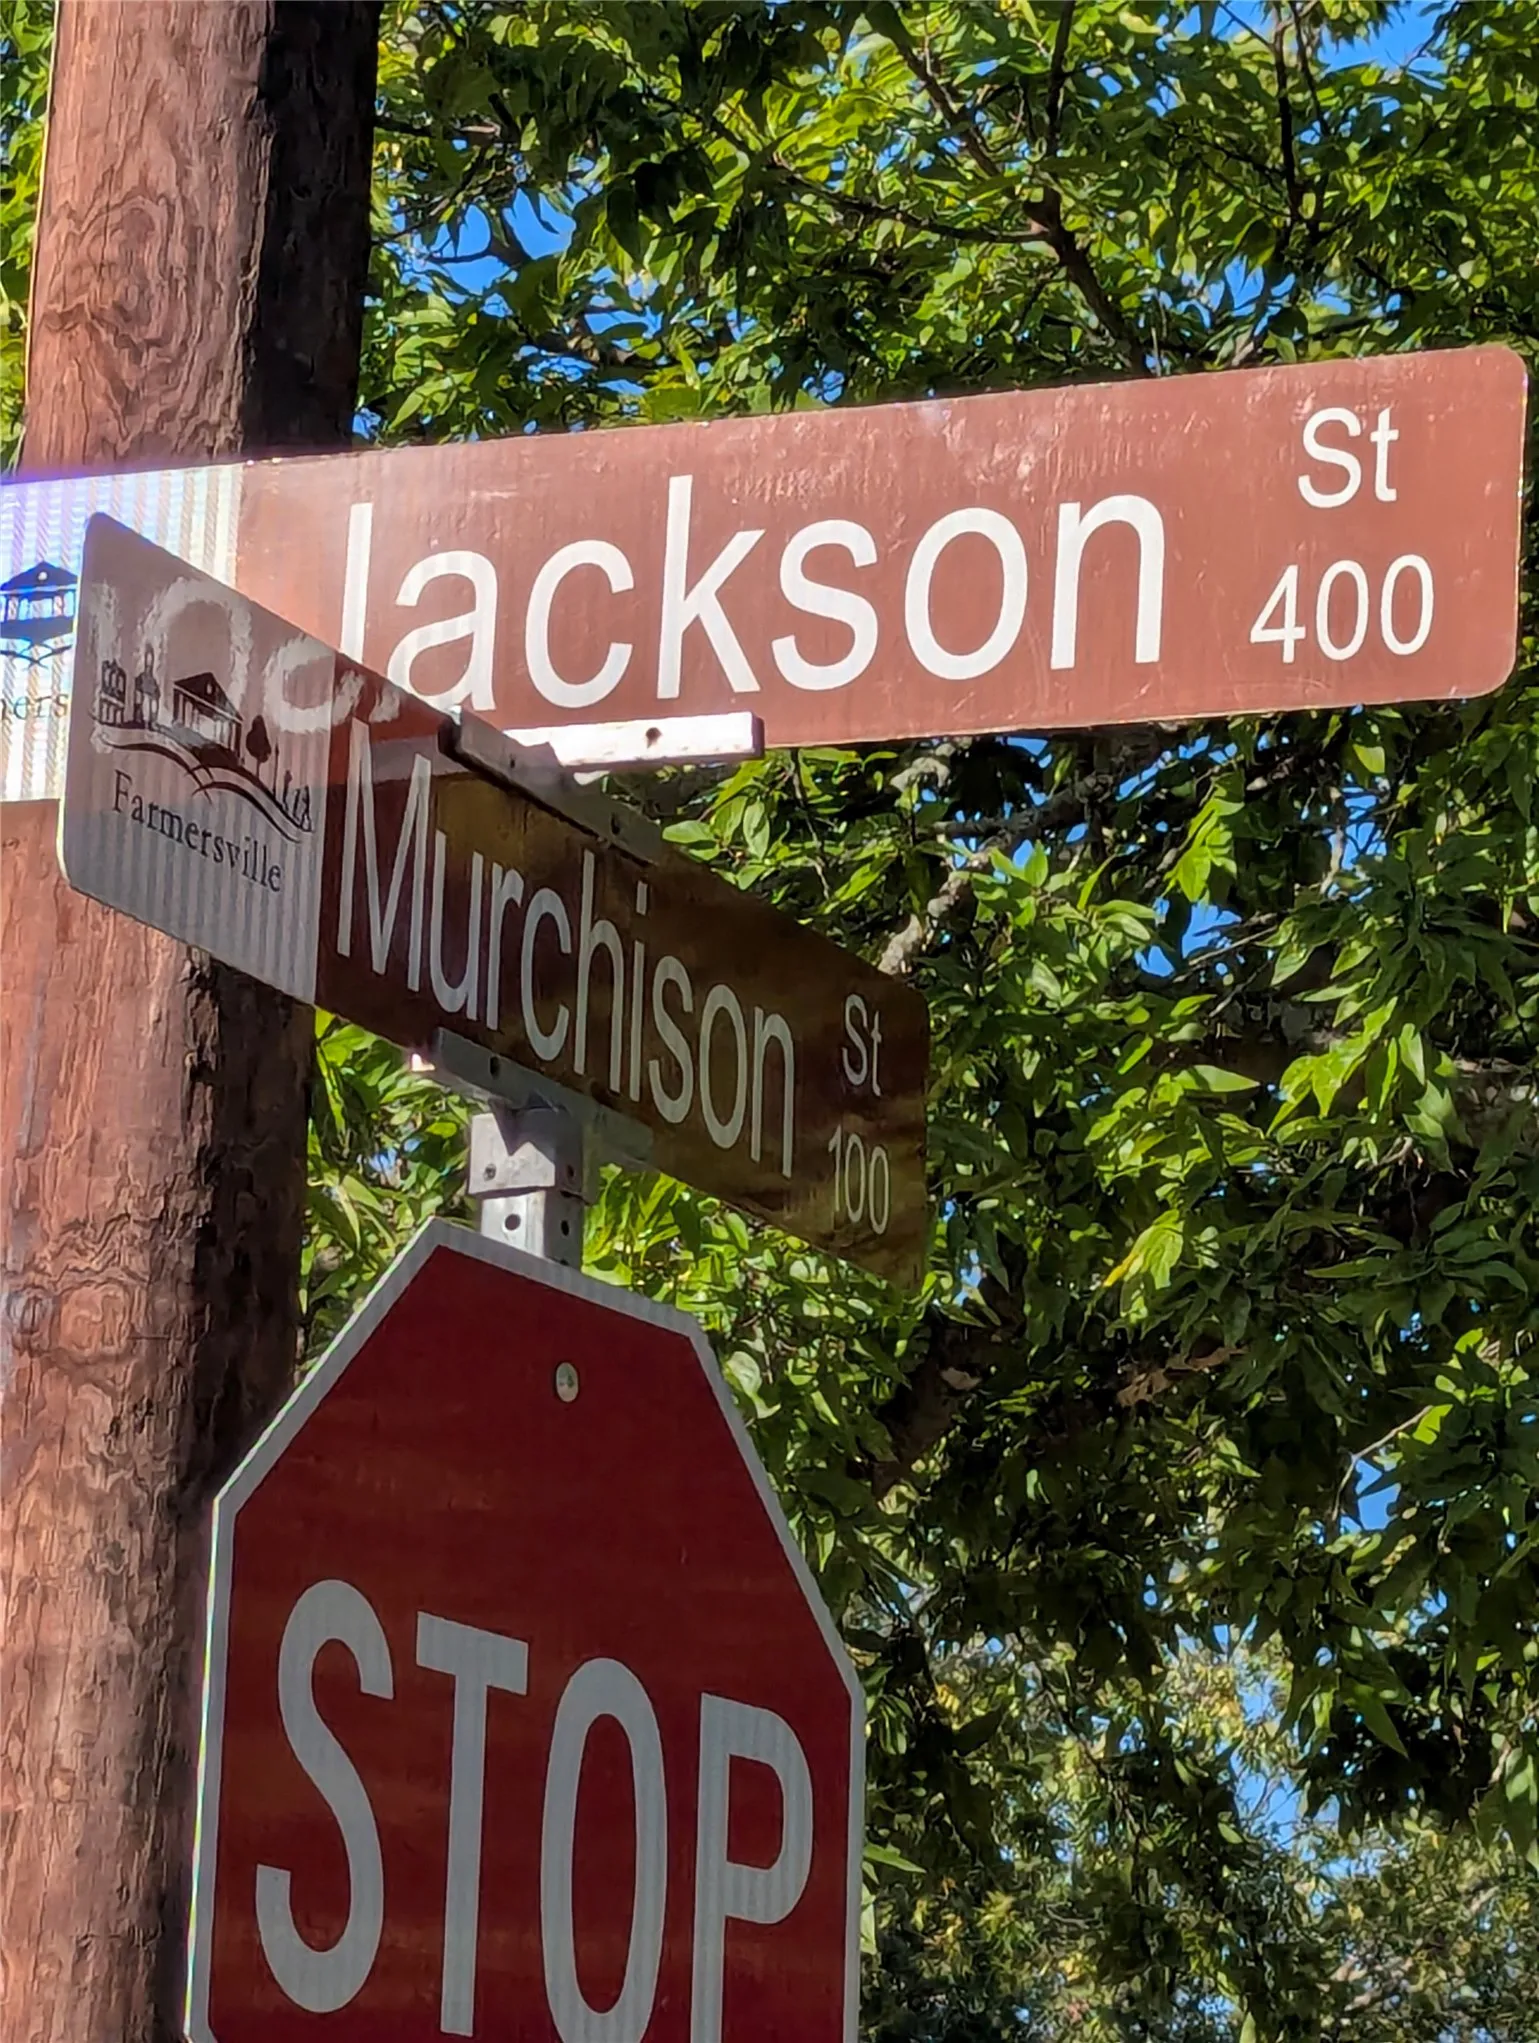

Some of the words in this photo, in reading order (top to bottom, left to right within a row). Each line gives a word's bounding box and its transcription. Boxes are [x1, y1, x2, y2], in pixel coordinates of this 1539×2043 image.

[1297, 406, 1399, 509] St
[1249, 553, 1434, 664] 400
[112, 769, 282, 893] Farmersville
[336, 717, 795, 1179] Murchison
[842, 993, 883, 1097] St
[828, 1124, 889, 1235] 100
[255, 1578, 814, 2043] STOP
